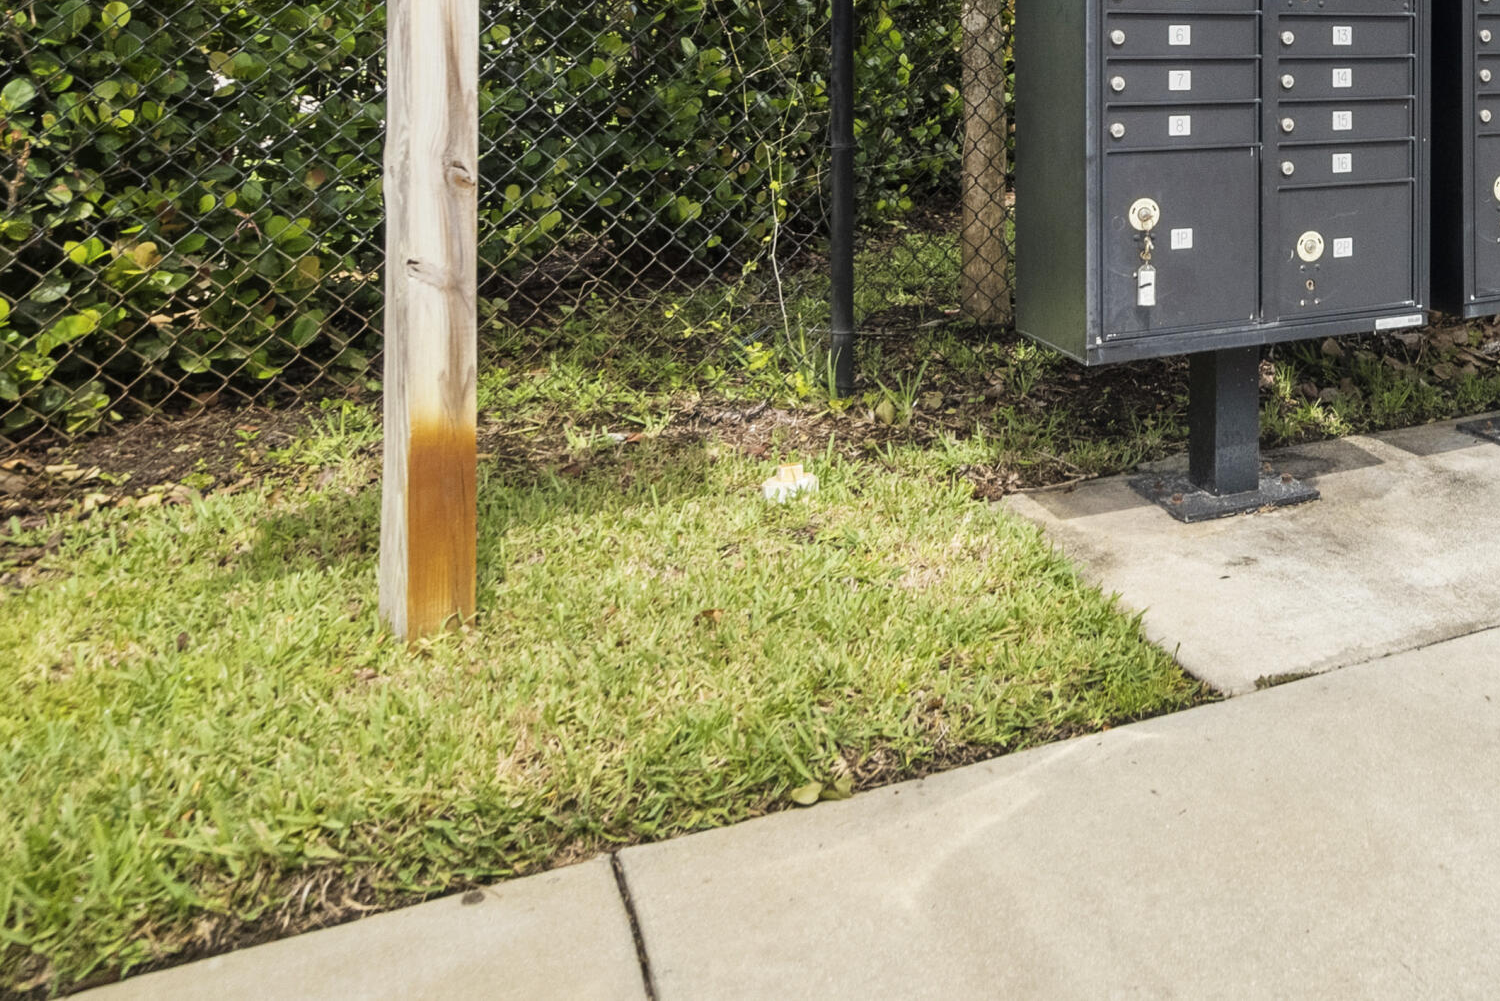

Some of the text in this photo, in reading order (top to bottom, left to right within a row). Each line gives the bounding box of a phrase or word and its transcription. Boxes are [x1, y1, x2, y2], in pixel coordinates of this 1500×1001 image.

[1176, 28, 1184, 43] 6
[1337, 29, 1348, 43] 13
[1177, 73, 1184, 87] 7
[1337, 71, 1348, 85] 14
[1176, 118, 1184, 133] 8
[1337, 114, 1348, 128] 15
[1337, 156, 1348, 171] 16
[1177, 231, 1188, 246] 1P
[1336, 241, 1350, 255] 2P
